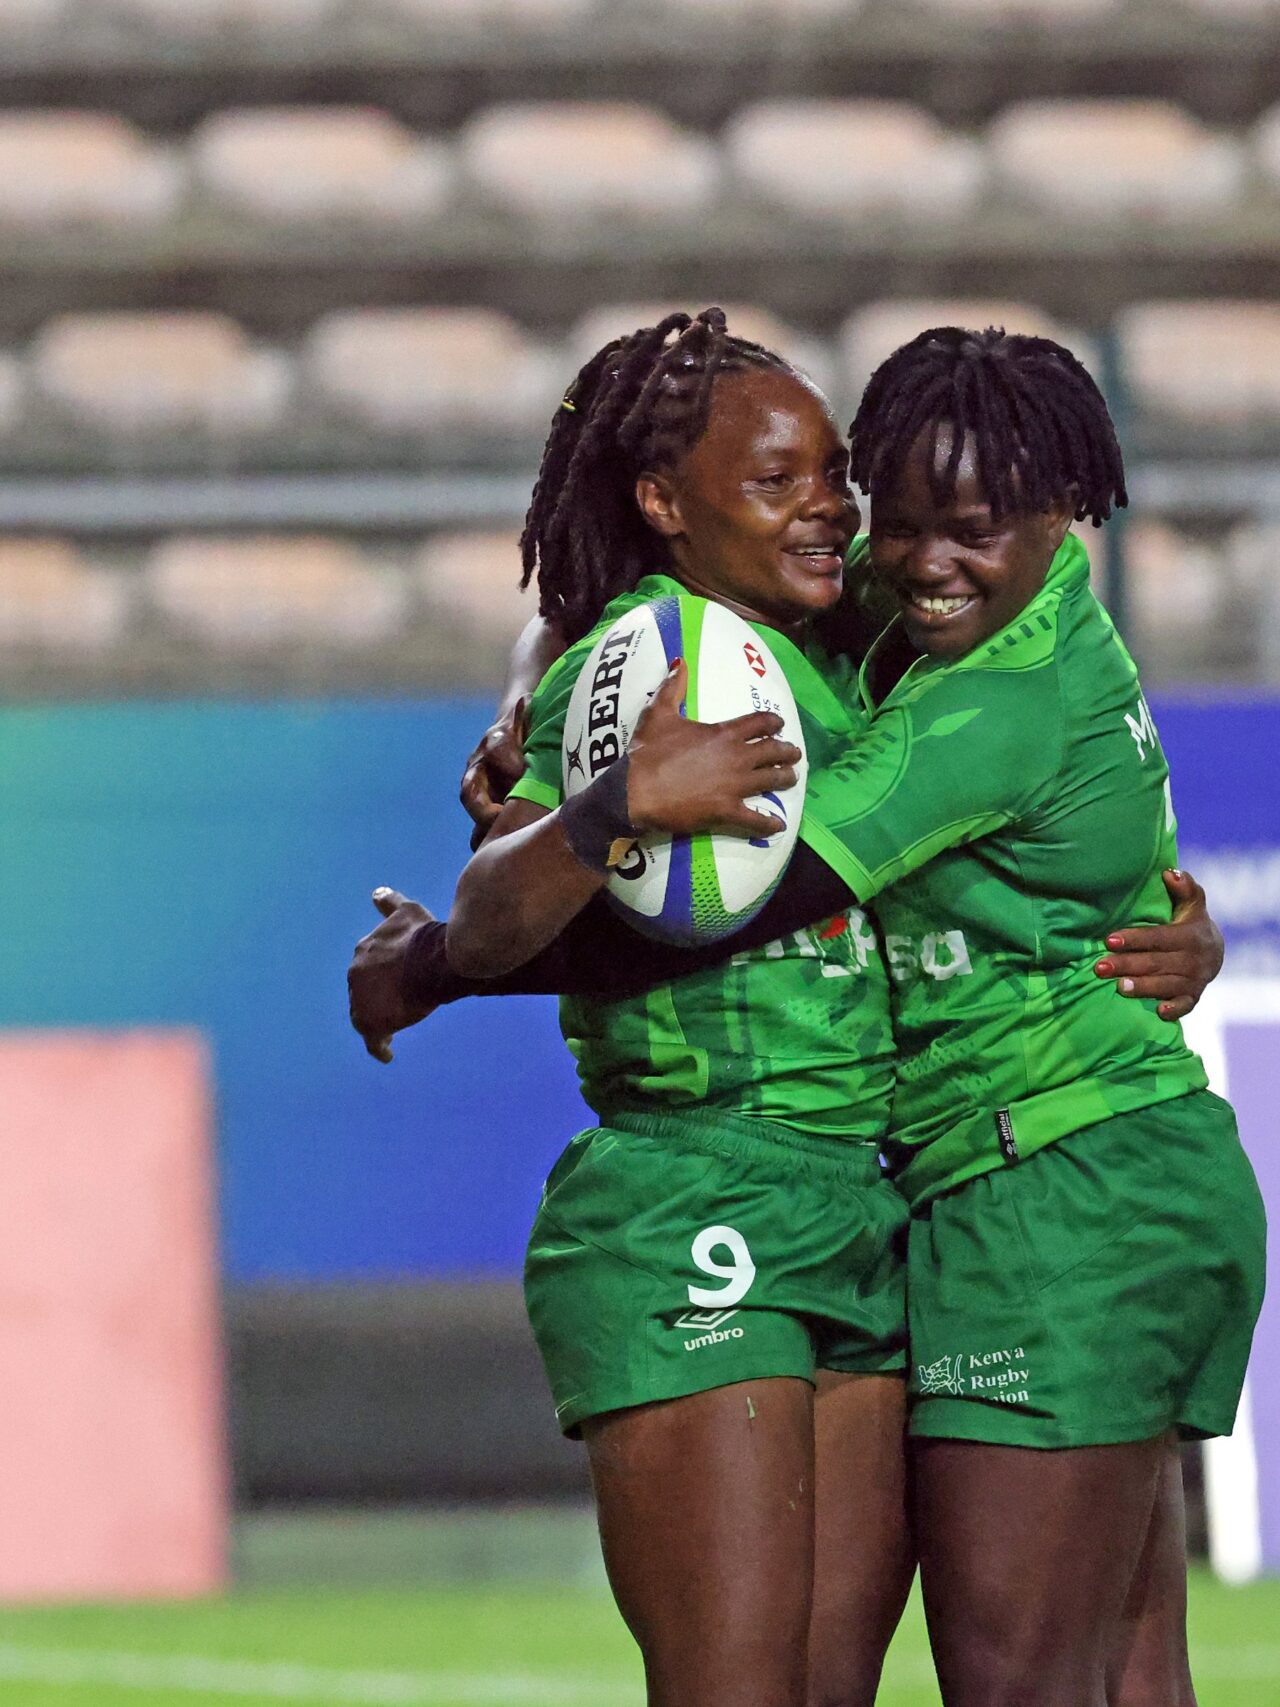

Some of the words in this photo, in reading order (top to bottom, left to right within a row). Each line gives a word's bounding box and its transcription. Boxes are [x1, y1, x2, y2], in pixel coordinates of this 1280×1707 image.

[750, 685, 761, 712] GBY
[687, 1225, 756, 1308] 9
[684, 1327, 744, 1352] umbro
[969, 1346, 1025, 1369] Kenya
[970, 1368, 1030, 1390] Rugby
[981, 1389, 1030, 1404] ion
